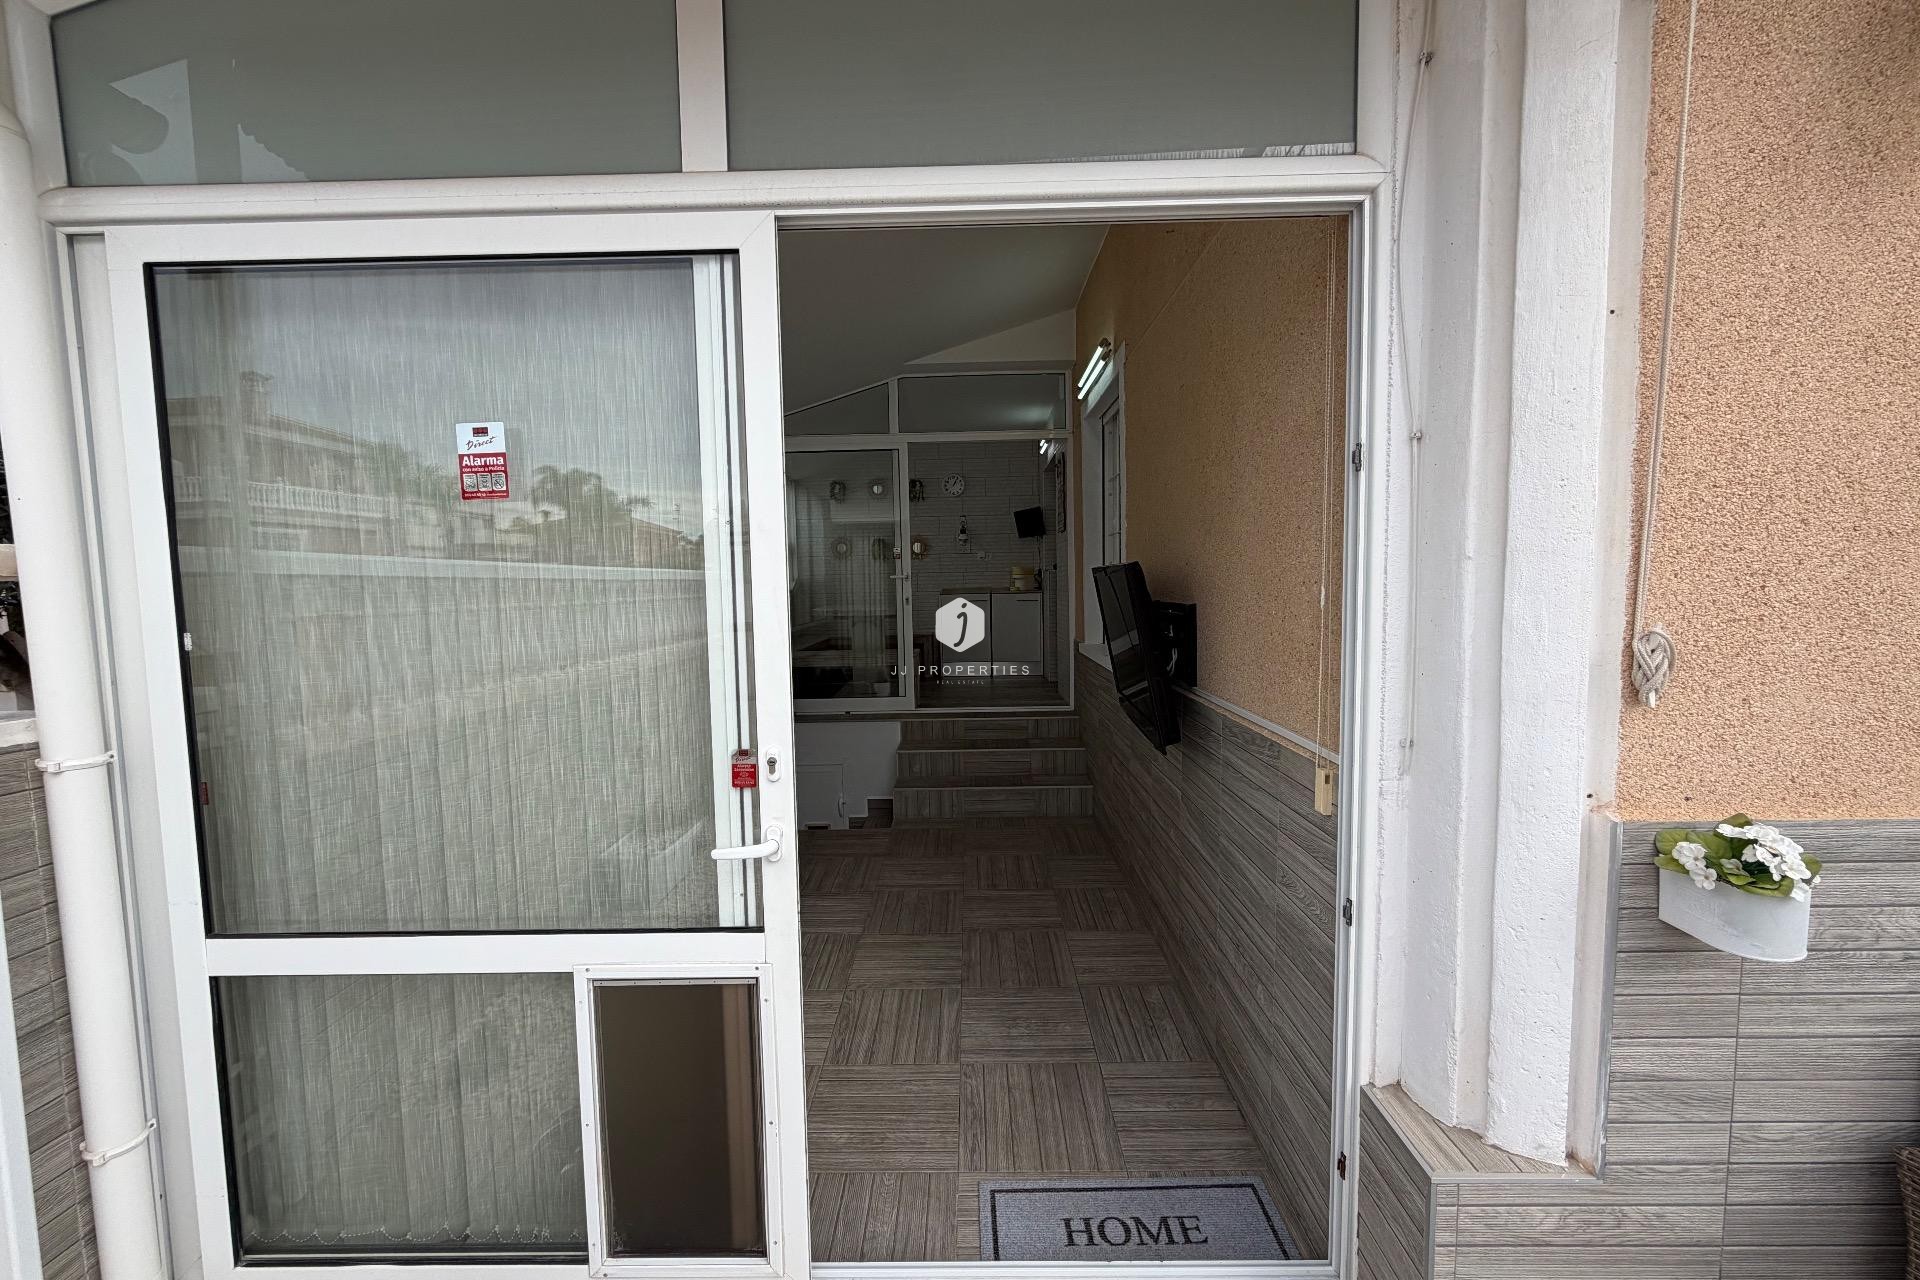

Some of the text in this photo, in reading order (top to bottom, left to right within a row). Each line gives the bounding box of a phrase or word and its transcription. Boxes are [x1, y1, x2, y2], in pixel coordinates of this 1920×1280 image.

[465, 436, 496, 450] Direct
[462, 455, 504, 466] Alarma
[1061, 1215, 1209, 1248] HOME
